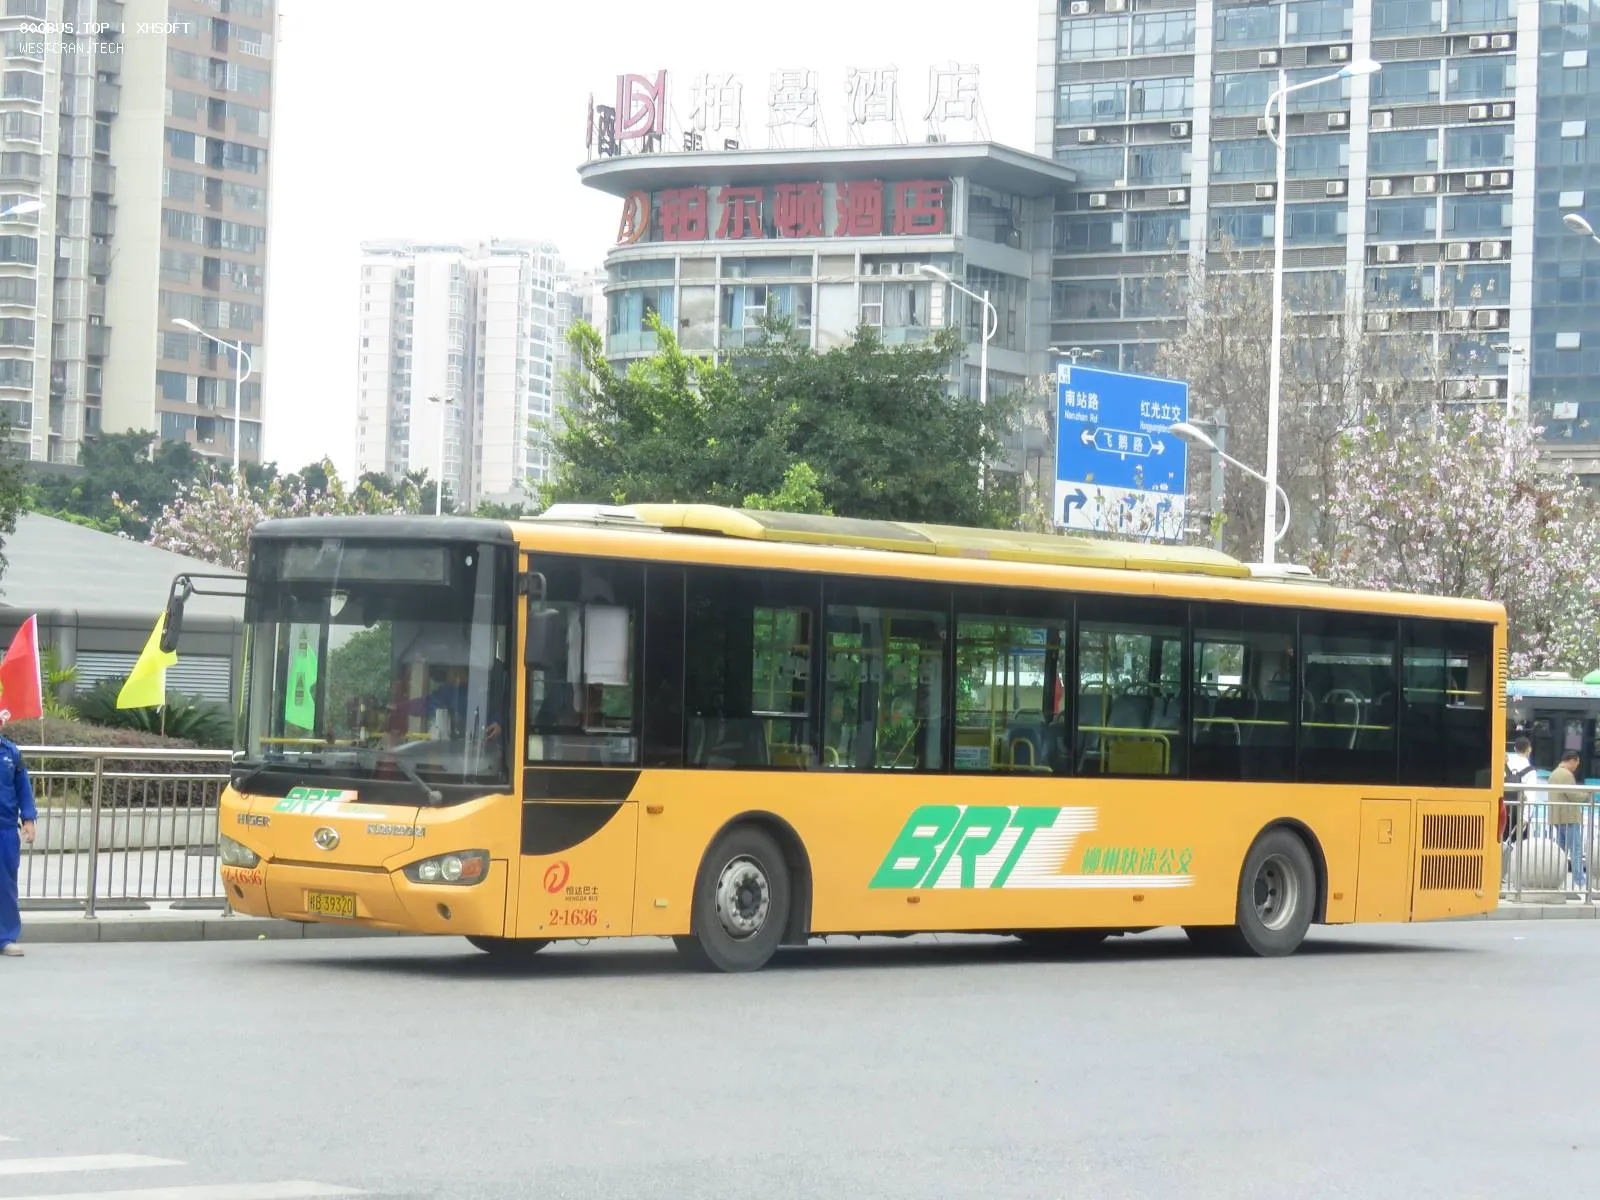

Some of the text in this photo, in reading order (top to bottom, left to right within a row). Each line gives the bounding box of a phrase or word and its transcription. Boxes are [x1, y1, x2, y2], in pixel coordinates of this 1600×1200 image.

[690, 62, 980, 130] 柏曼酒店
[659, 181, 950, 240] 铂尔顿酒店
[1064, 390, 1099, 411] 南站路
[1140, 400, 1181, 423] 红光立交
[1089, 413, 1098, 424] Rd
[272, 786, 345, 815] BRT
[237, 813, 271, 827] HIGER
[867, 804, 1063, 889] BRT
[1080, 847, 1194, 875] 柳州快速公交
[548, 908, 598, 927] 2-1636
